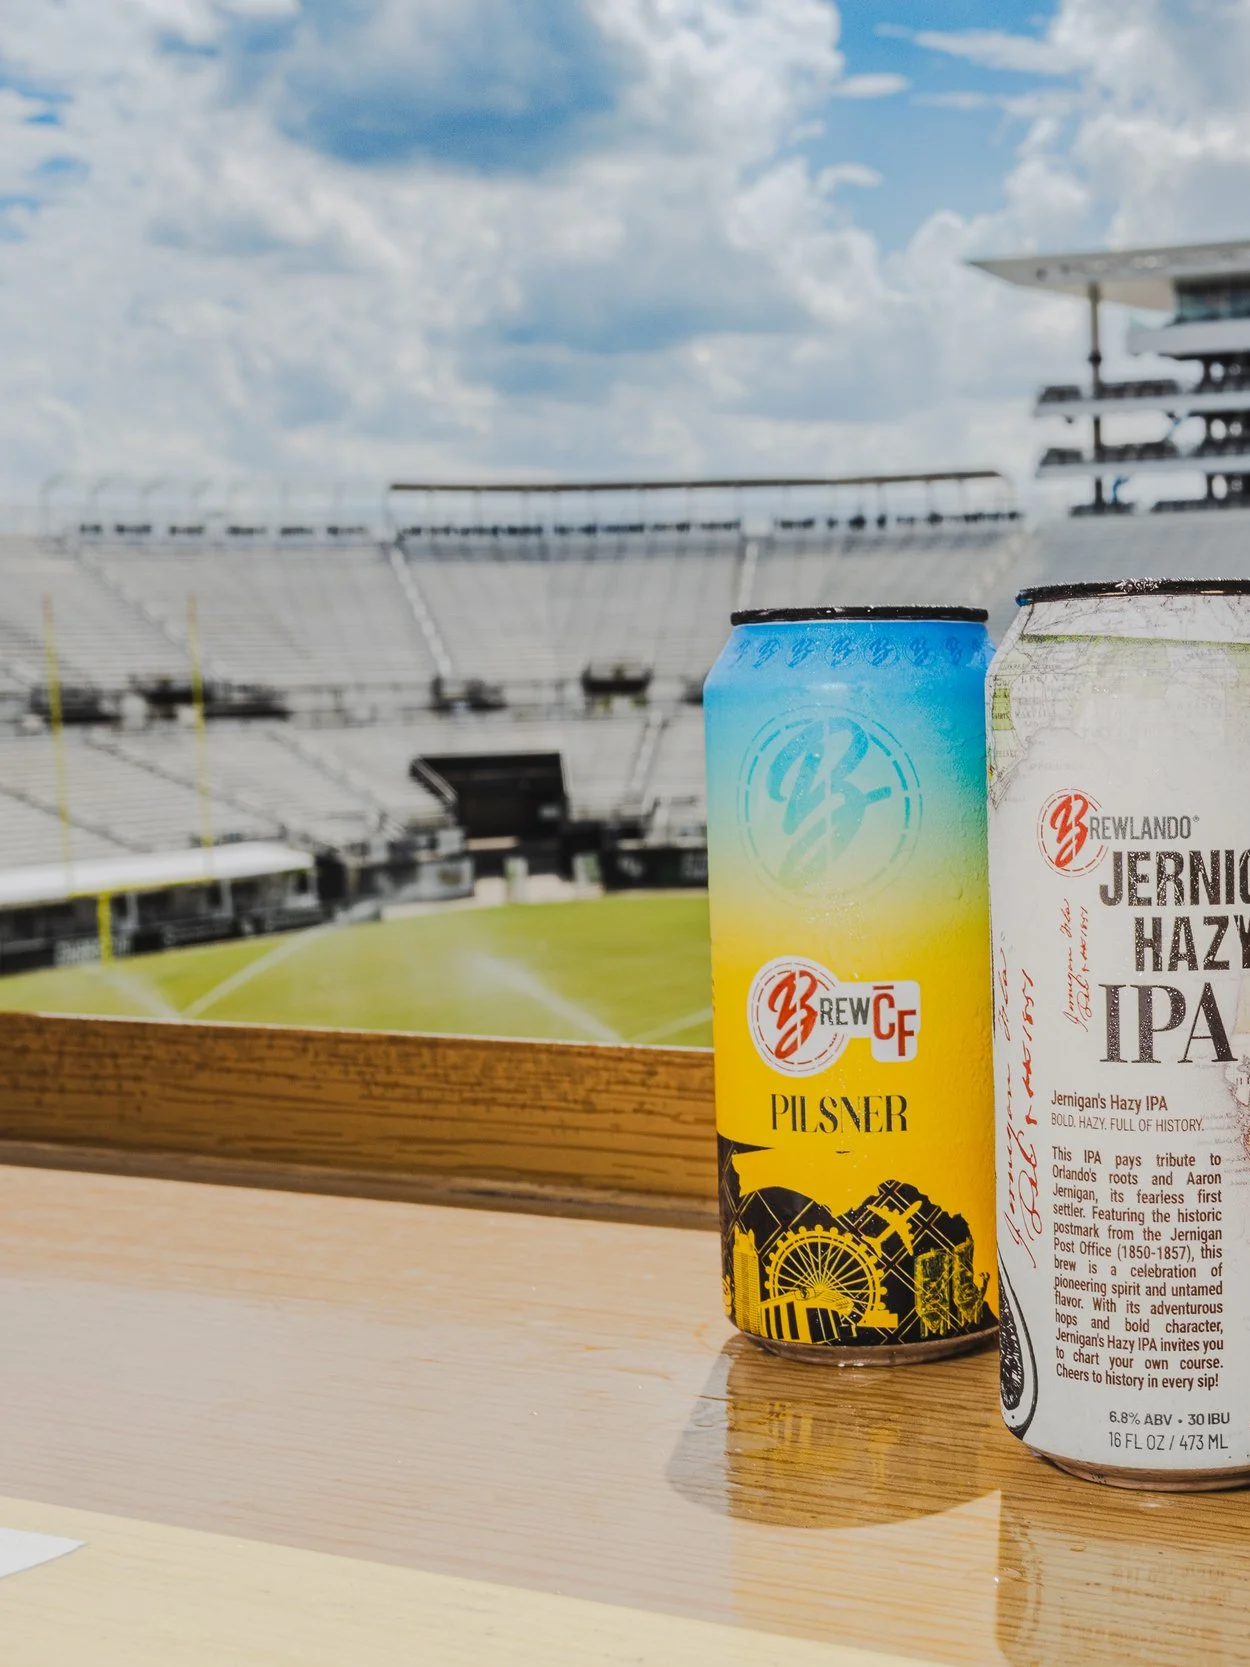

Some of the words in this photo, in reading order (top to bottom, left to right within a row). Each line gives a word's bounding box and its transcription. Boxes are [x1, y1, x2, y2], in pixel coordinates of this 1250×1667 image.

[1099, 982, 1238, 1064] IPA
[771, 1094, 907, 1133] PILSNER
[1051, 1090, 1106, 1111] Jernigan's
[1110, 1095, 1141, 1114] Hazy
[1146, 1096, 1168, 1111] IPA
[1051, 1113, 1076, 1128] BOLD.
[1079, 1116, 1107, 1130] HAZY.
[1110, 1117, 1136, 1131] FULL
[1139, 1119, 1152, 1132] OF
[1156, 1118, 1204, 1132] HISTORY.
[1052, 1146, 1072, 1161] This
[1084, 1150, 1101, 1164] IPA
[1116, 1154, 1142, 1170] pays
[1157, 1153, 1195, 1167] tribute
[1210, 1154, 1221, 1166] to
[1052, 1165, 1097, 1182] Orlando's
[1109, 1172, 1138, 1185] roots
[1152, 1172, 1173, 1186] and
[1187, 1173, 1221, 1185] Aaron
[1053, 1183, 1098, 1204] Jernigan,
[1110, 1189, 1124, 1203] its
[1137, 1190, 1184, 1204] fearless
[1197, 1190, 1222, 1203] first
[1053, 1204, 1086, 1218] settler.
[1092, 1206, 1144, 1225] Featuring
[1152, 1208, 1170, 1223] the
[1177, 1209, 1222, 1223] historic
[1053, 1221, 1099, 1238] postmark
[1108, 1223, 1134, 1241] from
[1143, 1227, 1161, 1241] the
[1171, 1227, 1222, 1244] Jernigan
[1054, 1238, 1075, 1254] Post
[1080, 1242, 1111, 1257] Office
[1117, 1246, 1194, 1262] (1850-1857),
[1201, 1244, 1222, 1258] this
[1054, 1255, 1076, 1272] brew
[1088, 1261, 1097, 1274] is
[1111, 1265, 1116, 1275] a
[1130, 1264, 1196, 1279] celebration
[1211, 1263, 1222, 1276] of
[1054, 1276, 1106, 1296] pioneering
[1111, 1282, 1140, 1298] spirit
[1146, 1282, 1166, 1296] and
[1172, 1281, 1222, 1296] untamed
[1055, 1292, 1083, 1309] flavor.
[1093, 1297, 1116, 1313] With
[1126, 1301, 1140, 1314] its
[1151, 1301, 1223, 1315] adventurous
[1055, 1309, 1077, 1328] hops
[1091, 1317, 1110, 1330] and
[1125, 1318, 1149, 1332] bold
[1165, 1319, 1223, 1334] character,
[1056, 1328, 1104, 1349] Jernigan's
[1108, 1336, 1134, 1353] Hazy
[1138, 1337, 1157, 1351] IPA
[1161, 1338, 1199, 1351] invites
[1203, 1339, 1224, 1355] you
[1056, 1346, 1064, 1359] to
[1073, 1350, 1099, 1365] chart
[1109, 1357, 1133, 1371] your
[1145, 1359, 1168, 1369] own
[1180, 1357, 1223, 1370] course.
[1056, 1363, 1089, 1382] Cheers
[1092, 1370, 1102, 1384] to
[1106, 1371, 1144, 1390] history
[1148, 1375, 1158, 1388] in
[1162, 1377, 1193, 1392] every
[1197, 1374, 1218, 1391] sip!
[1109, 1411, 1140, 1425] 6.8%
[1144, 1414, 1172, 1426] ABV
[1188, 1413, 1205, 1426] 30
[1208, 1412, 1230, 1425] IBU
[1109, 1433, 1121, 1448] 16
[1126, 1433, 1143, 1450] FL
[1146, 1435, 1165, 1450] OZ
[1180, 1435, 1204, 1450] 473
[1208, 1433, 1228, 1449] ML
